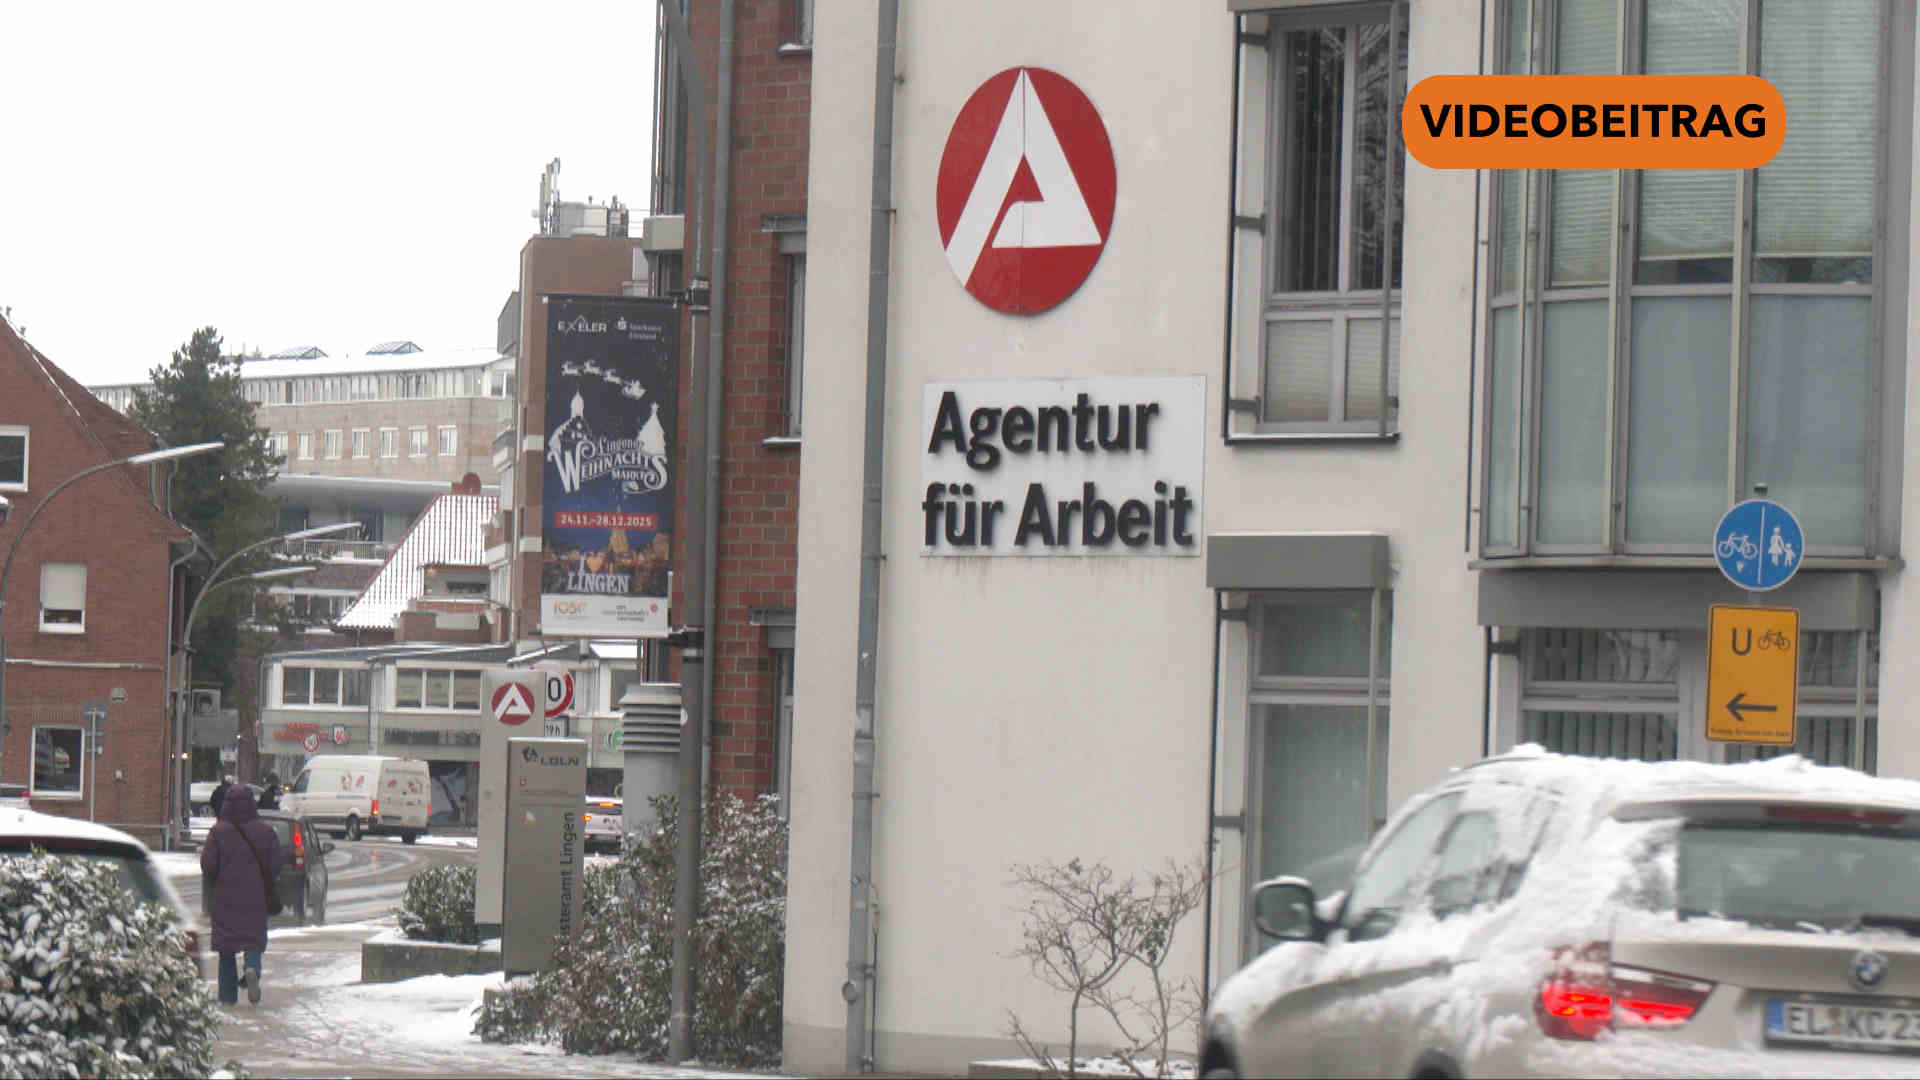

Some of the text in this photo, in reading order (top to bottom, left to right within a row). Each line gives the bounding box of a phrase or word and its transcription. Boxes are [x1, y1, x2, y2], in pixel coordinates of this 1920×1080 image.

[928, 391, 1160, 470] Agentur
[922, 481, 1193, 546] für Arbeit
[567, 573, 632, 593] LINGEN
[1732, 628, 1753, 656] U
[548, 677, 562, 702] 0
[560, 811, 577, 865] Lingen
[1790, 1006, 1825, 1035] EL
